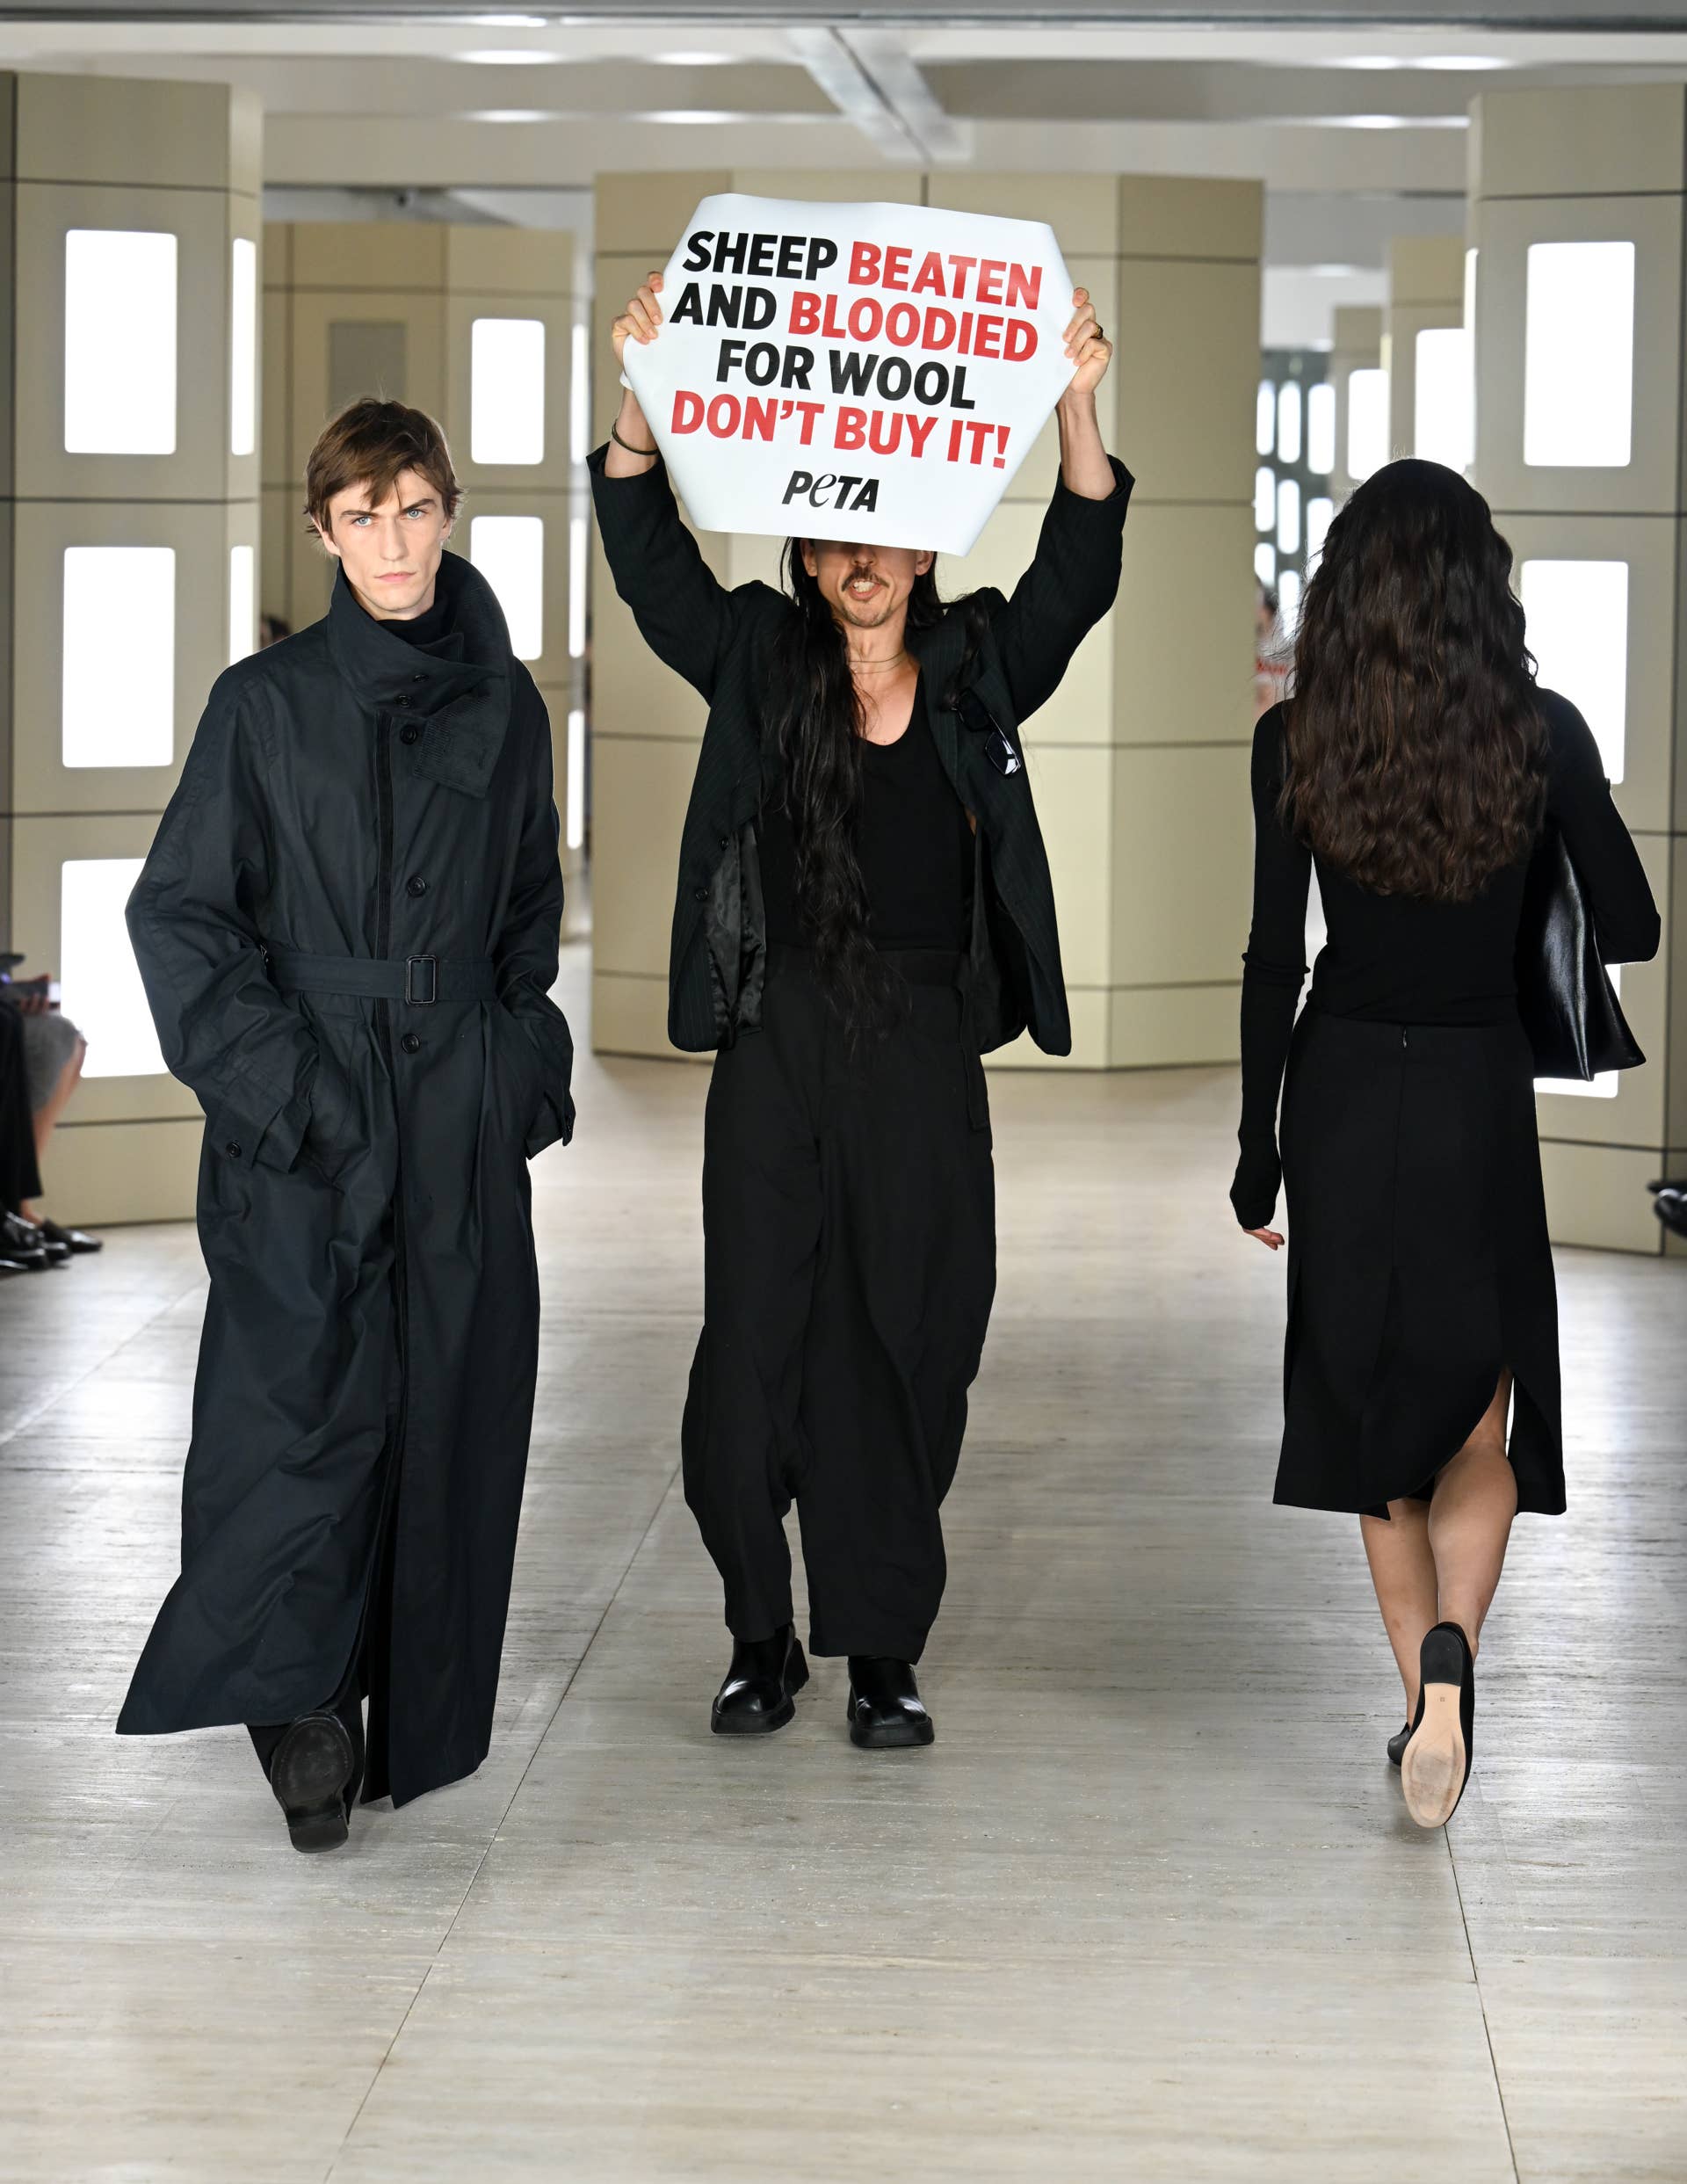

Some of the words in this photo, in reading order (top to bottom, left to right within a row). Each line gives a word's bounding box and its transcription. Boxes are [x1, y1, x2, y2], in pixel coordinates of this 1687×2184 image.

[682, 230, 838, 281] SHEEP
[848, 241, 1043, 310] BEATEN
[669, 282, 778, 330] AND
[788, 291, 1039, 362] BLOODIED
[715, 338, 815, 391] FOR
[829, 349, 975, 410] WOOL
[670, 390, 825, 446] DON’T
[834, 406, 939, 458] BUY
[946, 419, 1011, 469] IT!
